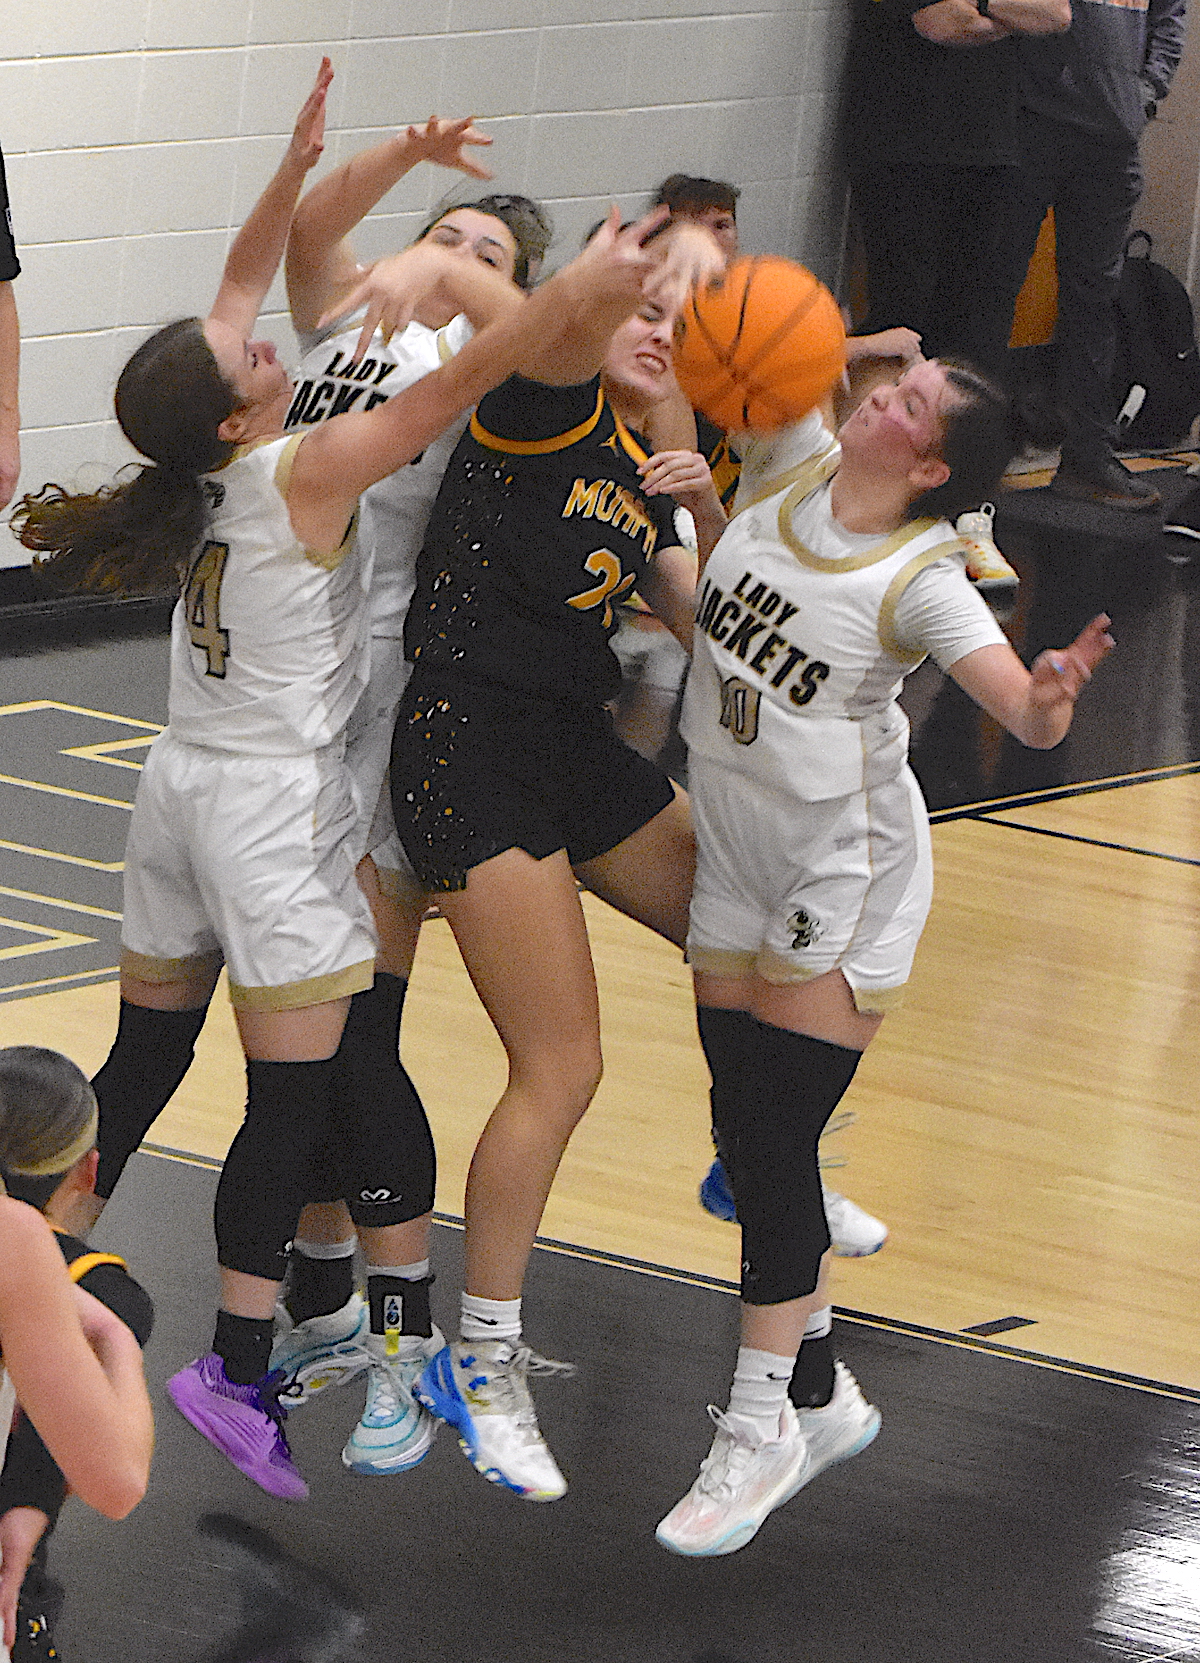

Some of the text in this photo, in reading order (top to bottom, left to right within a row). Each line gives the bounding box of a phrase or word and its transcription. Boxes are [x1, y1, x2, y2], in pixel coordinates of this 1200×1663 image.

[324, 351, 399, 386] LADY
[185, 540, 230, 680] 4
[733, 571, 800, 628] LADY
